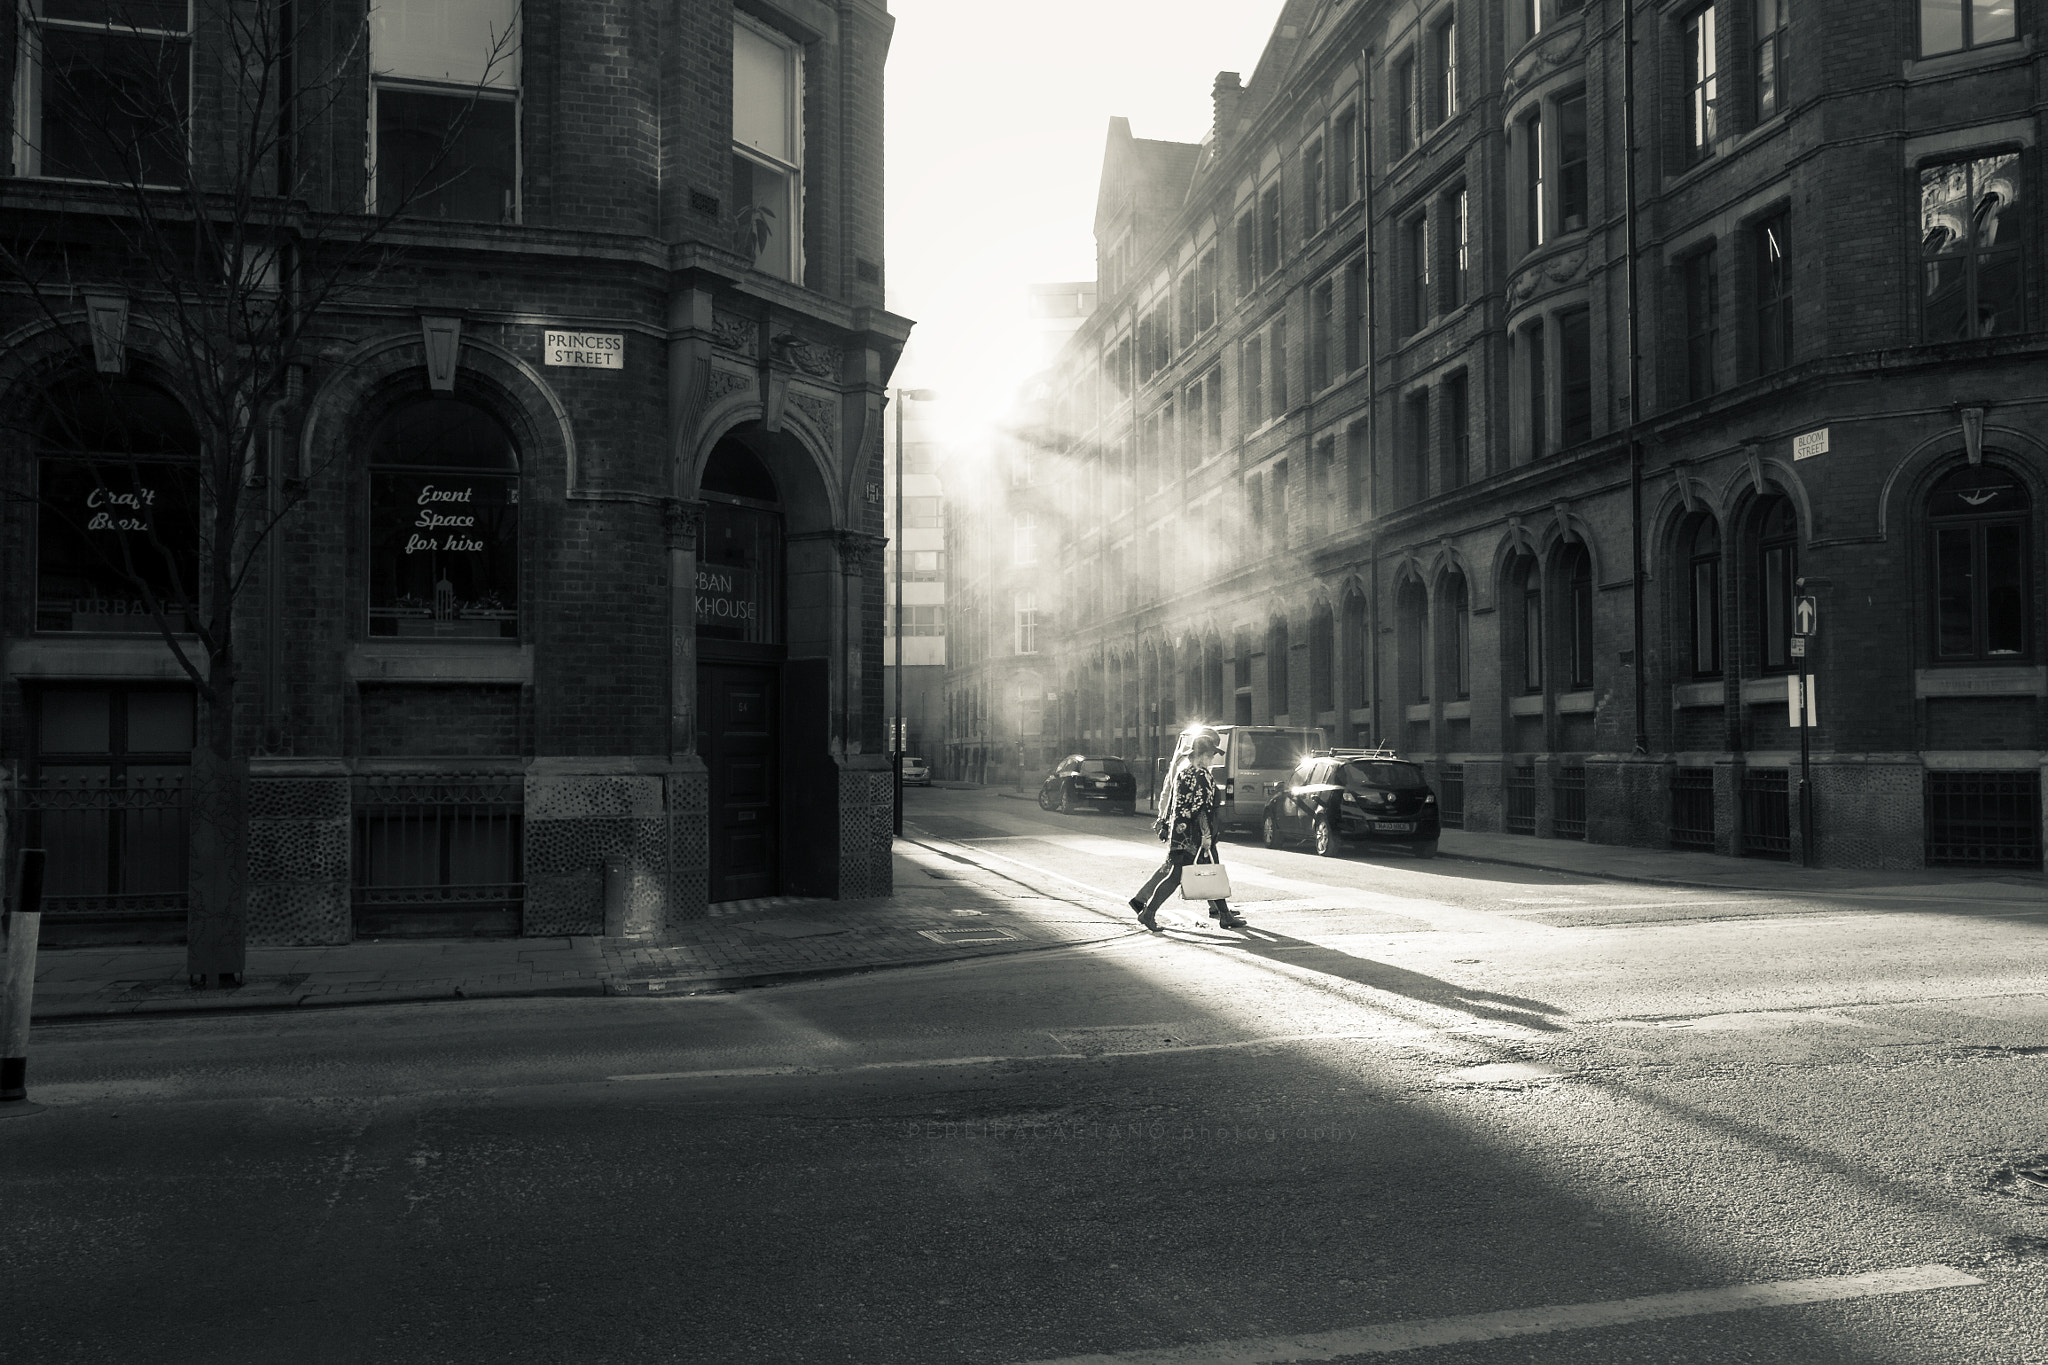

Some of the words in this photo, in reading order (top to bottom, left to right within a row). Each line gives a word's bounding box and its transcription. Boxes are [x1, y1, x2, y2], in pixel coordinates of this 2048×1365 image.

[548, 334, 620, 350] PRINCESS
[555, 350, 613, 365] STREET
[1798, 431, 1823, 447] BLOOM
[1798, 442, 1824, 458] STREET
[417, 485, 472, 505] Event
[415, 509, 475, 531] Space
[405, 534, 438, 554] for
[443, 535, 484, 552] hire
[675, 636, 690, 657] 54
